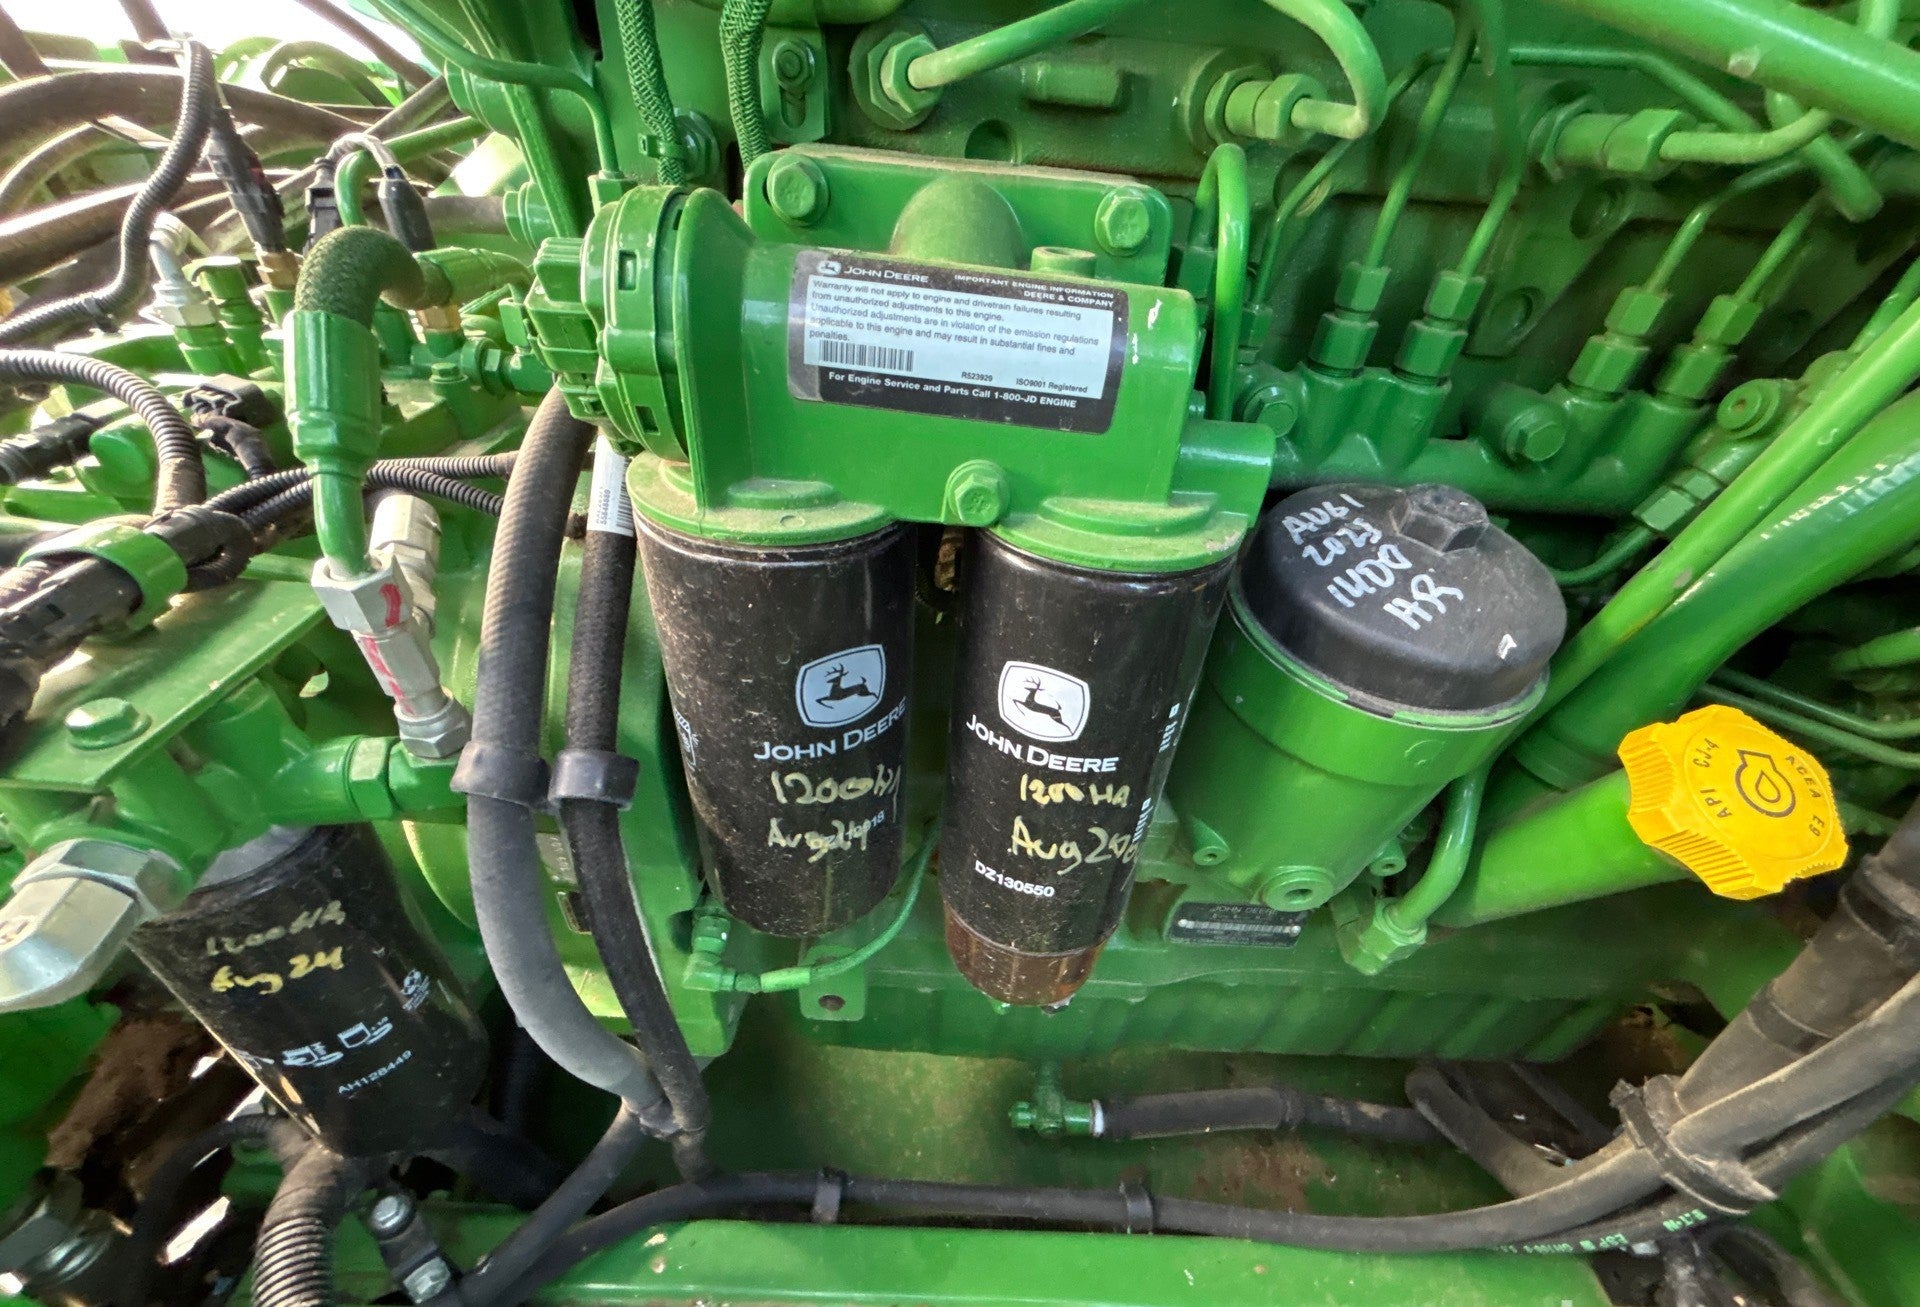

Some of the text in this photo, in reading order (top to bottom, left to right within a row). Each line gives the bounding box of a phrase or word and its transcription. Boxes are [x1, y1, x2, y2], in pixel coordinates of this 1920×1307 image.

[844, 266, 930, 283] JOHN DEERE
[954, 274, 1114, 299] IMPORTANT ENGINE INFORMATION
[812, 290, 1005, 322] from unauthorized adjustments to this engine.
[814, 280, 1082, 321] Warranty will not apply to engine and drivetrain failures resulting
[1024, 290, 1114, 308] DEERE & COMPANY
[808, 329, 850, 342] penalties.
[810, 302, 1099, 346] Unauthorized adjustments are in violation of the emission regulations
[810, 316, 1076, 356] applicable to this engine and may result in substantial fines and
[828, 371, 1078, 408] For Engine Service and Parts Call 1-800-JD ENGINE
[1016, 378, 1088, 394] ISO9001 Registered
[1326, 543, 1414, 608] 1400
[753, 696, 906, 761] JOHN DEERE
[966, 714, 1120, 773] JOHN DEERE
[1785, 755, 1822, 798] ACEA
[1700, 788, 1732, 818] API
[974, 860, 1055, 898] DZ130550
